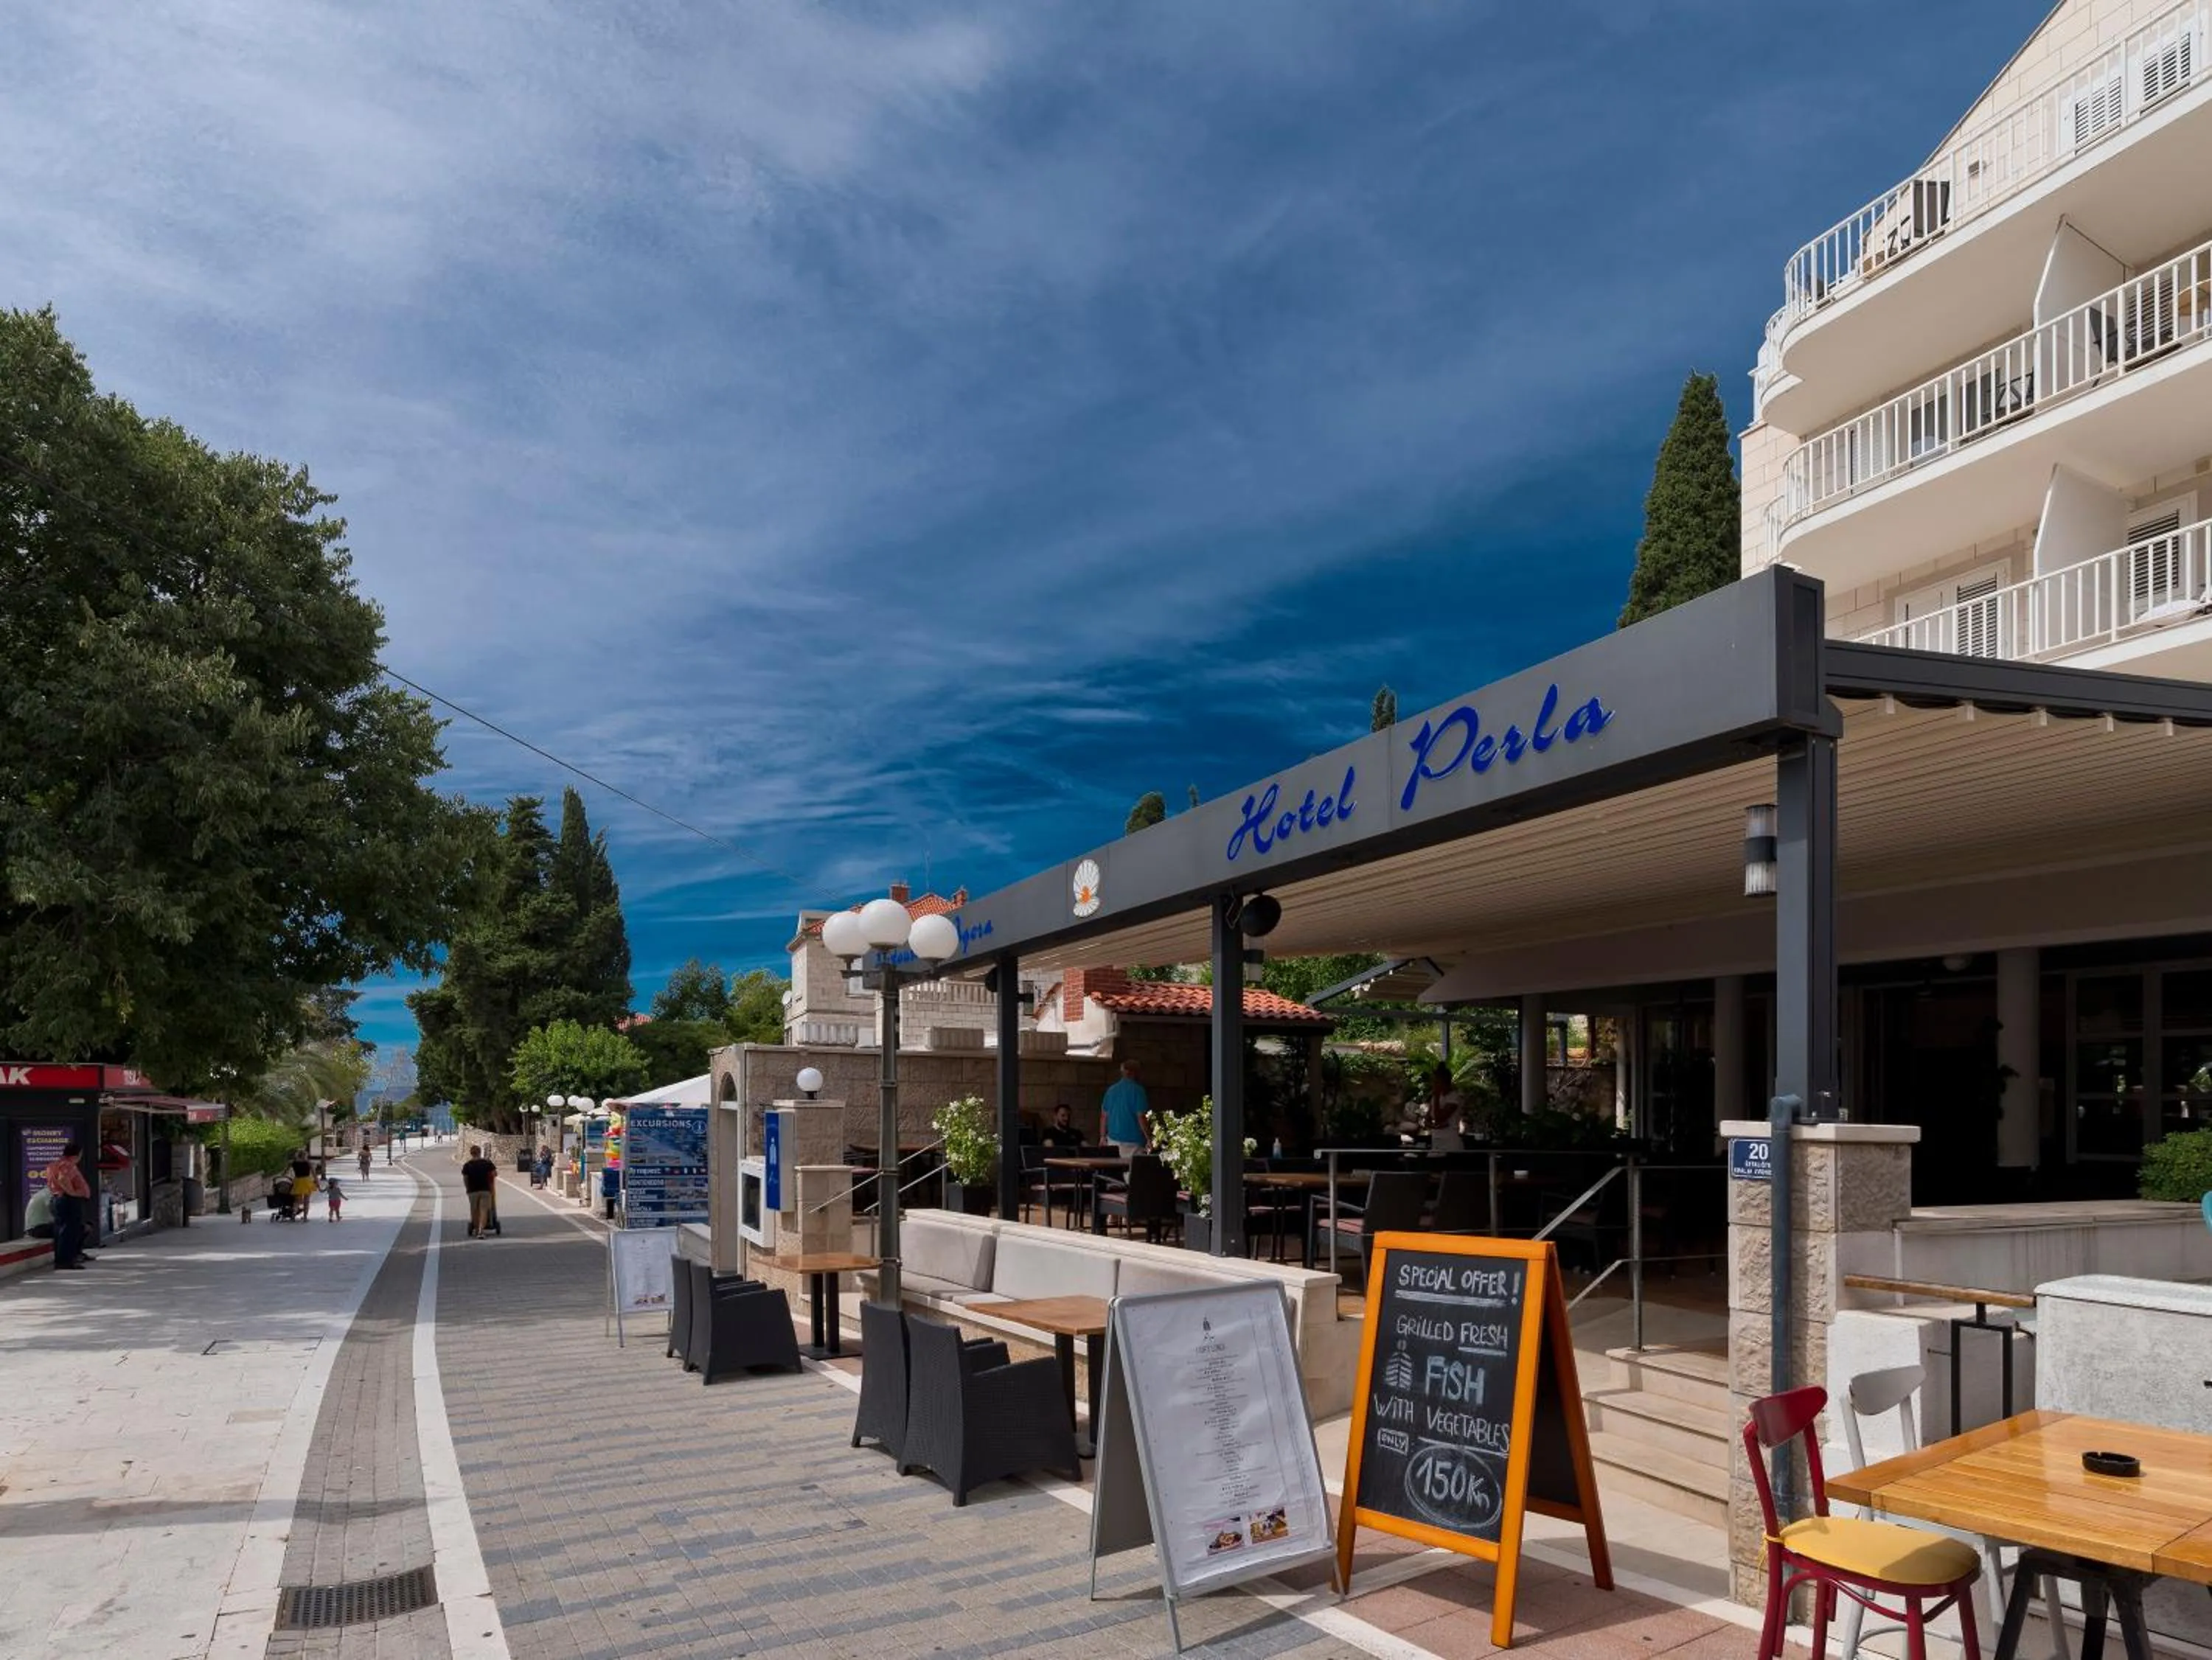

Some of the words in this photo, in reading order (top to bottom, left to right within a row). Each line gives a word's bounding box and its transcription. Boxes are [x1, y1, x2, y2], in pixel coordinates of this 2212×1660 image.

[1225, 767, 1356, 861] Hotel
[1399, 683, 1615, 812] Perla
[630, 1120, 692, 1129] EXCURSIONS
[1748, 1143, 1769, 1159] 20
[1397, 1315, 1455, 1342] GRILLED
[1460, 1322, 1509, 1349] FRESH
[1425, 1356, 1485, 1405] FISH
[1427, 1405, 1510, 1454] VEGETABLES
